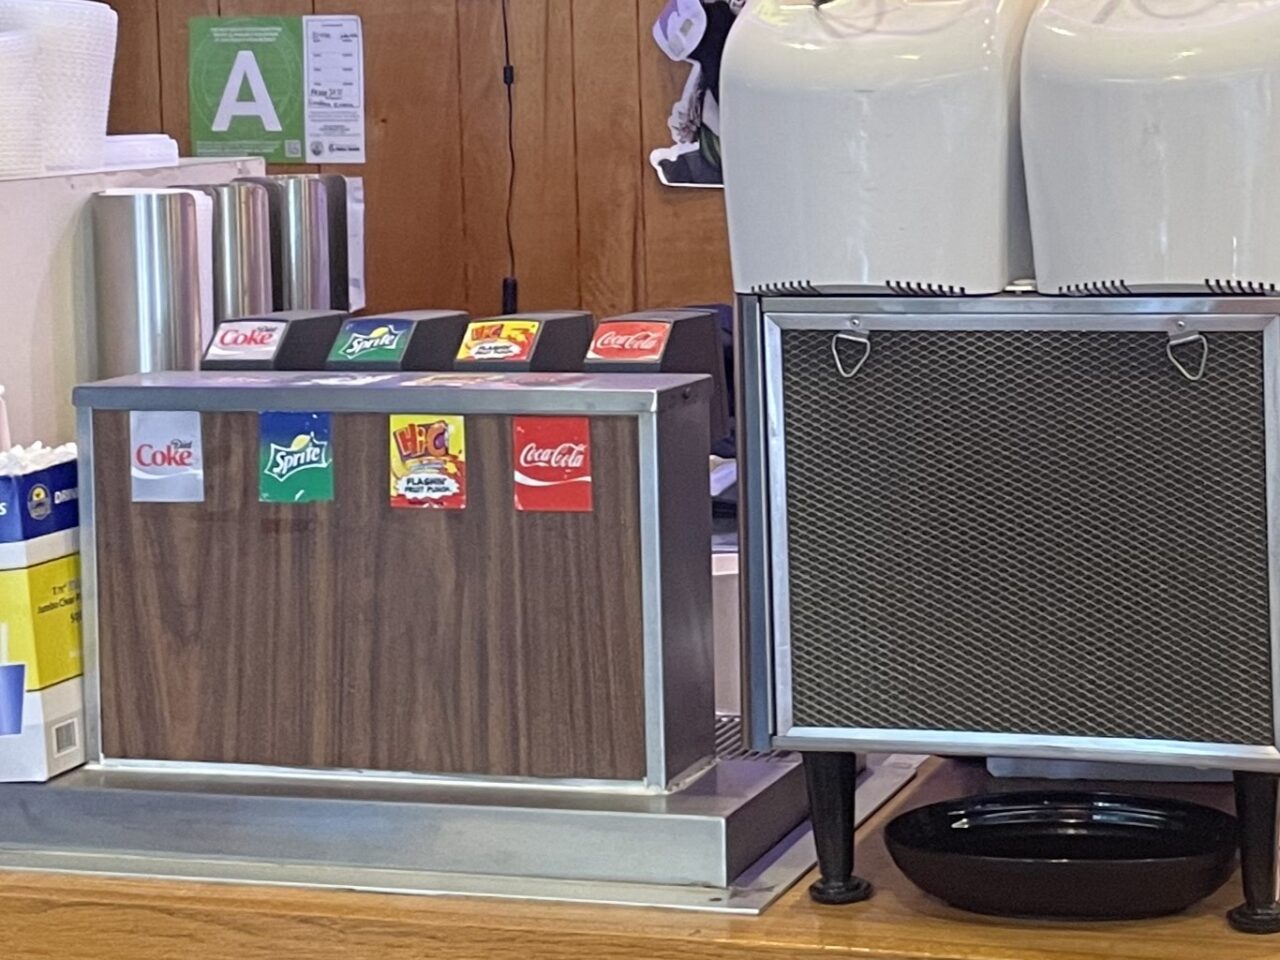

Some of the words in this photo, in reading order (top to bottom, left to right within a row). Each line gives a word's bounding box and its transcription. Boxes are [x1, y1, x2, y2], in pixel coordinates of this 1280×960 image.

[211, 50, 283, 131] A
[219, 326, 275, 347] Coke
[350, 331, 396, 355] Sprite
[597, 330, 661, 351] Coca-Cola
[136, 443, 193, 467] Coke
[273, 443, 321, 475] Sprite
[519, 443, 588, 468] Coca-Cola
